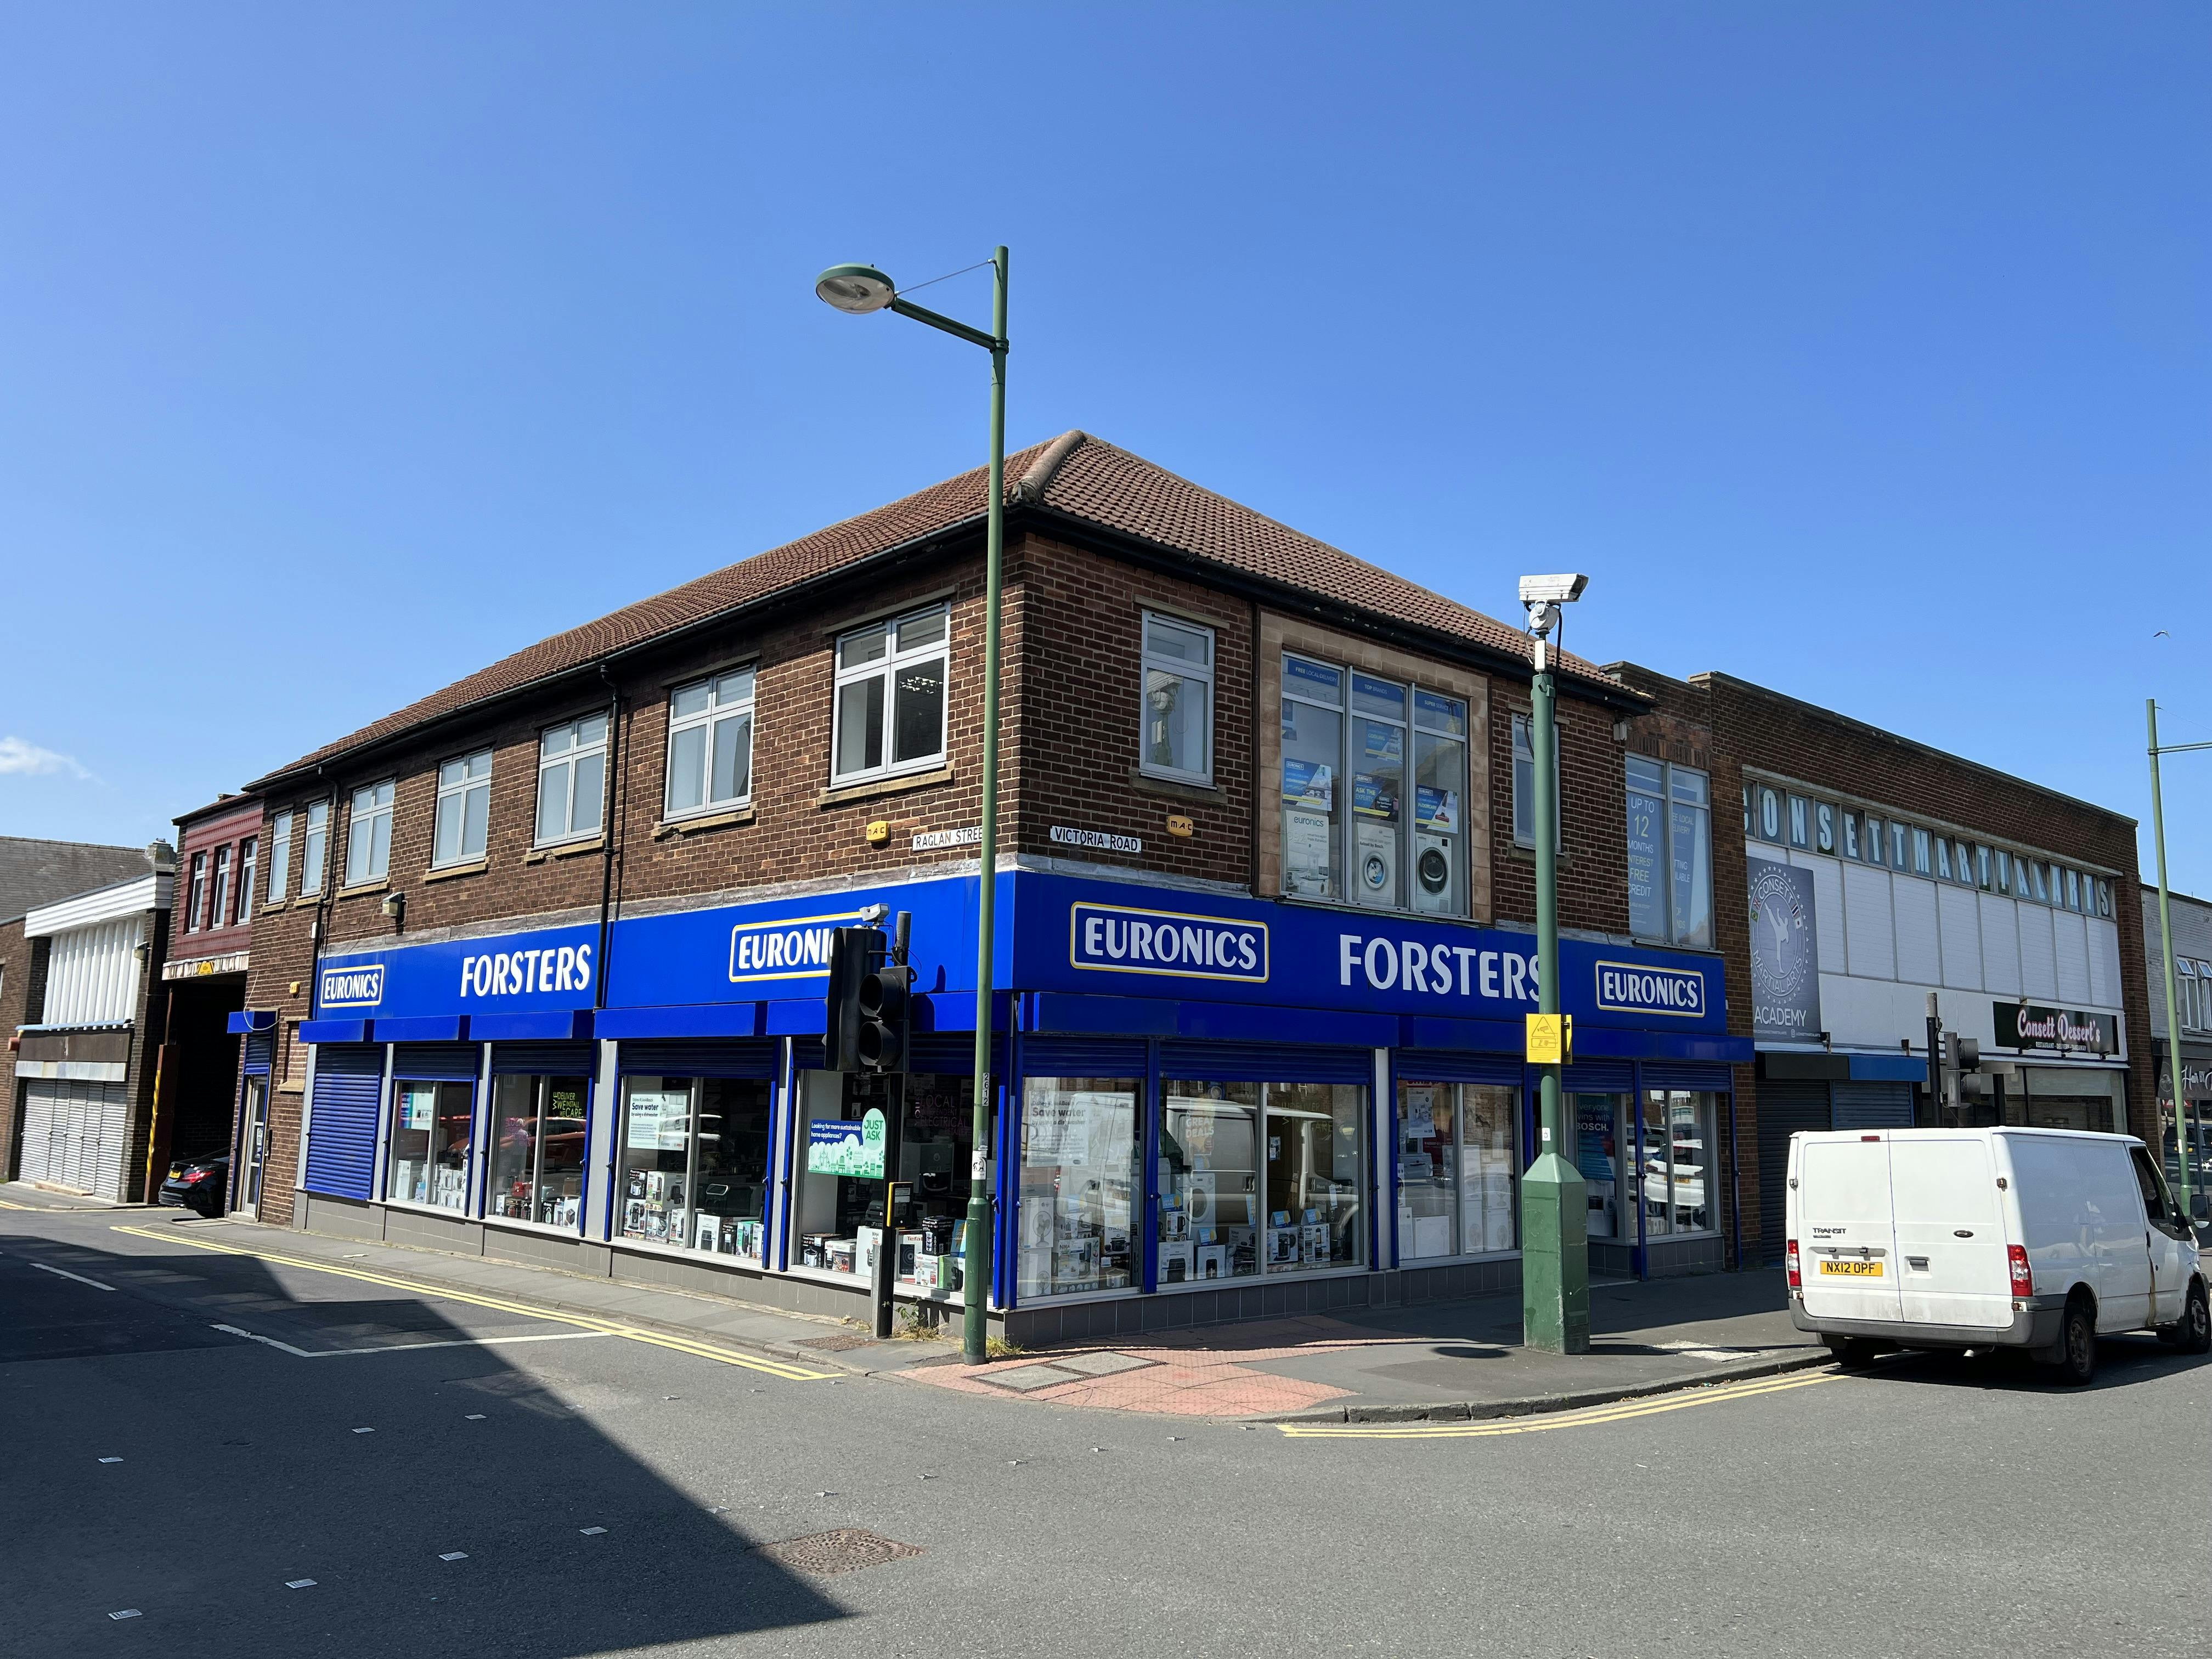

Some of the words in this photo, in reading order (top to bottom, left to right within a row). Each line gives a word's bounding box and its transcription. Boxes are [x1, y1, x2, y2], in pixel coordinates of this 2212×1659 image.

[1306, 668, 1319, 678] LOCAL
[1319, 673, 1338, 682] DELIVERY
[1373, 686, 1387, 694] BRANDS
[1631, 797, 1642, 809] UP
[1645, 800, 1655, 813] TO
[1294, 816, 1324, 827] euronics
[1635, 814, 1649, 838] 12
[1679, 814, 1694, 826] LOCAL
[1672, 825, 1690, 834] ELIVERY
[917, 833, 951, 848] RAGLAN
[956, 827, 983, 843] STREE
[1055, 827, 1104, 847] VICTORIA
[1111, 835, 1138, 851] ROAD
[1627, 839, 1654, 854] MONTHS
[1628, 854, 1654, 867] NTEREST
[1674, 859, 1688, 870] TTING
[1629, 867, 1650, 882] FREE
[1913, 829, 2046, 900] MARTIAL
[2050, 865, 2109, 916] ARTS
[1758, 878, 1793, 905] CONSETT
[738, 928, 833, 969] EURONI
[1085, 917, 1257, 970] EURONICS
[460, 944, 591, 997] FORSTERS
[1753, 949, 1785, 994] MARTIAL
[1786, 955, 1802, 990] ARTS
[324, 973, 379, 1000] EURONICS
[1604, 972, 1698, 1008] EURONICS
[1754, 1006, 1807, 1027] ACADEMY
[2017, 1008, 2056, 1039] Consett
[2057, 1013, 2100, 1043] Dessert's
[557, 1092, 575, 1101] DELIVER
[557, 1100, 566, 1110] WE
[632, 1102, 644, 1110] Save
[1032, 1107, 1056, 1117] Save
[1058, 1108, 1086, 1117] water
[864, 1120, 883, 1130] JUST
[921, 1116, 967, 1128] ELECTRICAL
[1186, 1118, 1214, 1126] GREAT
[866, 1130, 881, 1141] ASK
[1186, 1127, 1214, 1138] DEALS
[1826, 1262, 1850, 1273] NX12
[1854, 1263, 1875, 1274] OPF
